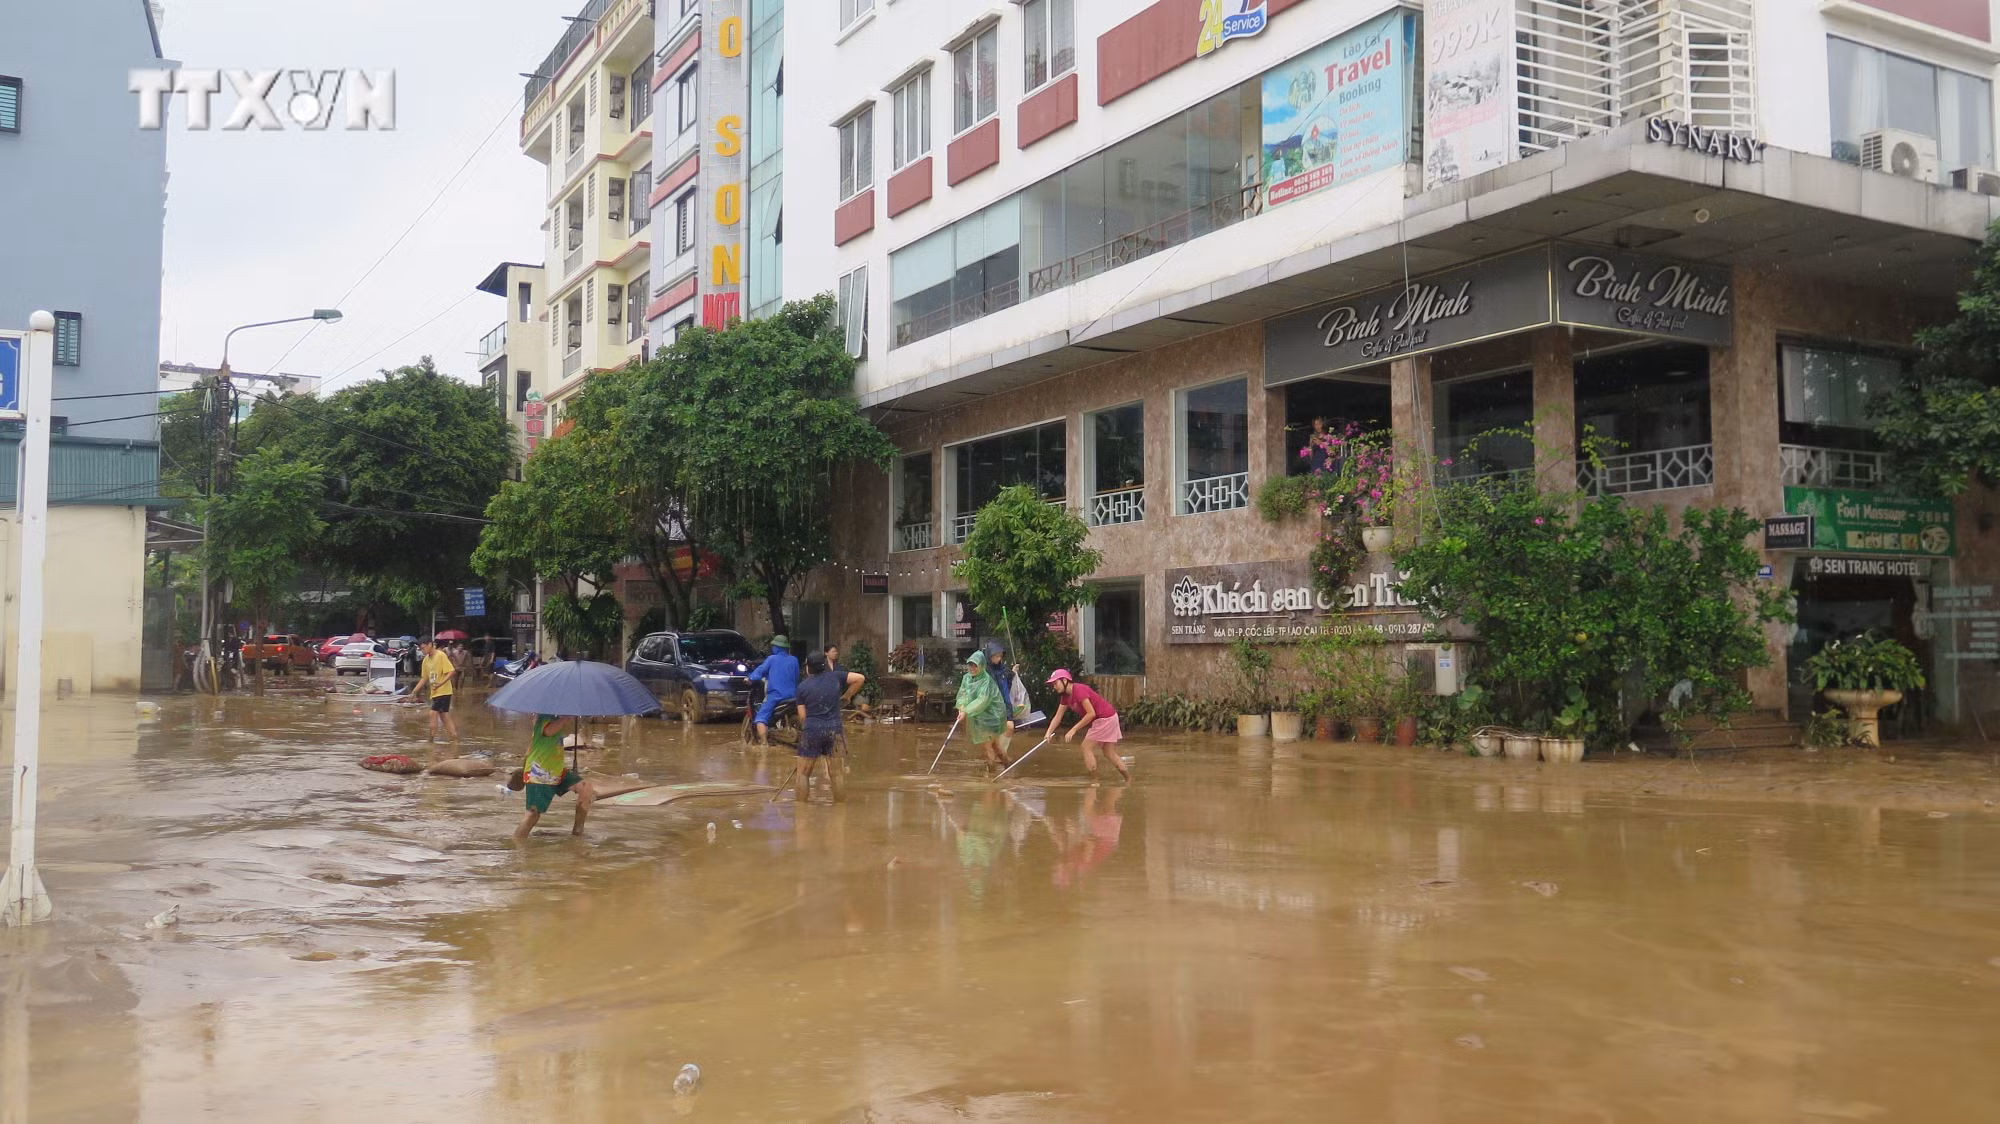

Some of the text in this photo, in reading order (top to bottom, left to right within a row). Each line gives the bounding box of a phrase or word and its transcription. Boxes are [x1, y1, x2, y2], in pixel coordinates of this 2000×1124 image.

[1224, 15, 1261, 36] Service
[1431, 7, 1501, 65] 999K
[1324, 37, 1392, 93] Travel
[1340, 78, 1382, 105] Booking
[1649, 116, 1761, 162] SYNARY
[1648, 265, 1729, 315] Minh
[1387, 281, 1471, 332] Minh
[1836, 501, 1860, 520] Foot
[1864, 504, 1907, 521] Massage
[1768, 522, 1806, 537] MASSAGE
[1825, 558, 1921, 576] SEN TRANG HOTEL
[1201, 579, 1269, 615] Khách
[1171, 620, 1206, 635] SEN TRẮNG
[1388, 623, 1406, 634] 0913
[1407, 623, 1421, 634] 287
